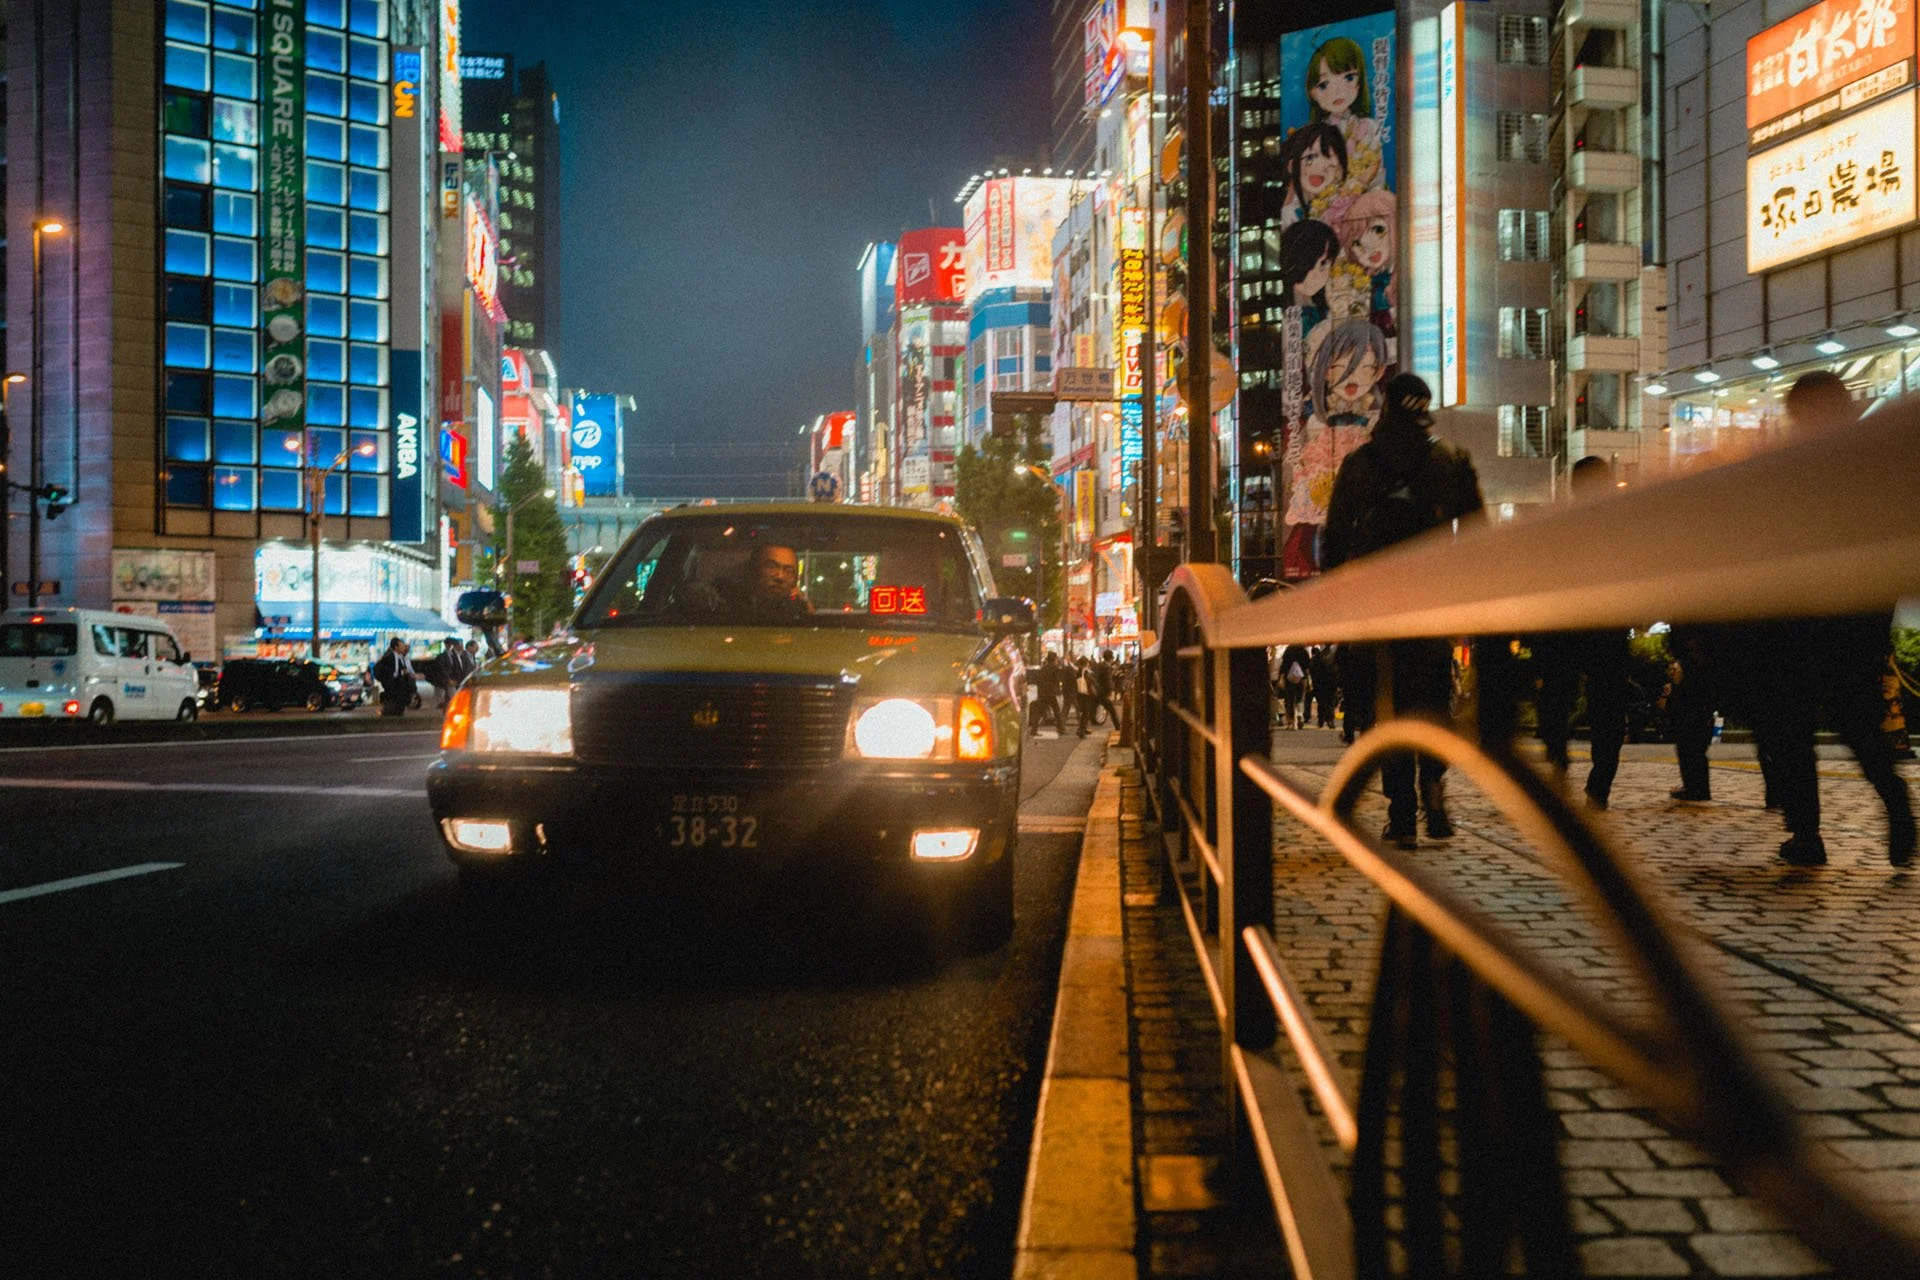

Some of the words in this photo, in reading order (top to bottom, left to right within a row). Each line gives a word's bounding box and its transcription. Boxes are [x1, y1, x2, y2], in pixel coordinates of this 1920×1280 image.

[270, 12, 294, 139] SQUARE
[1760, 150, 1901, 238] 塚田農場
[397, 412, 417, 479] AKIBA
[873, 587, 926, 613] 回送
[670, 815, 758, 848] 38-32
